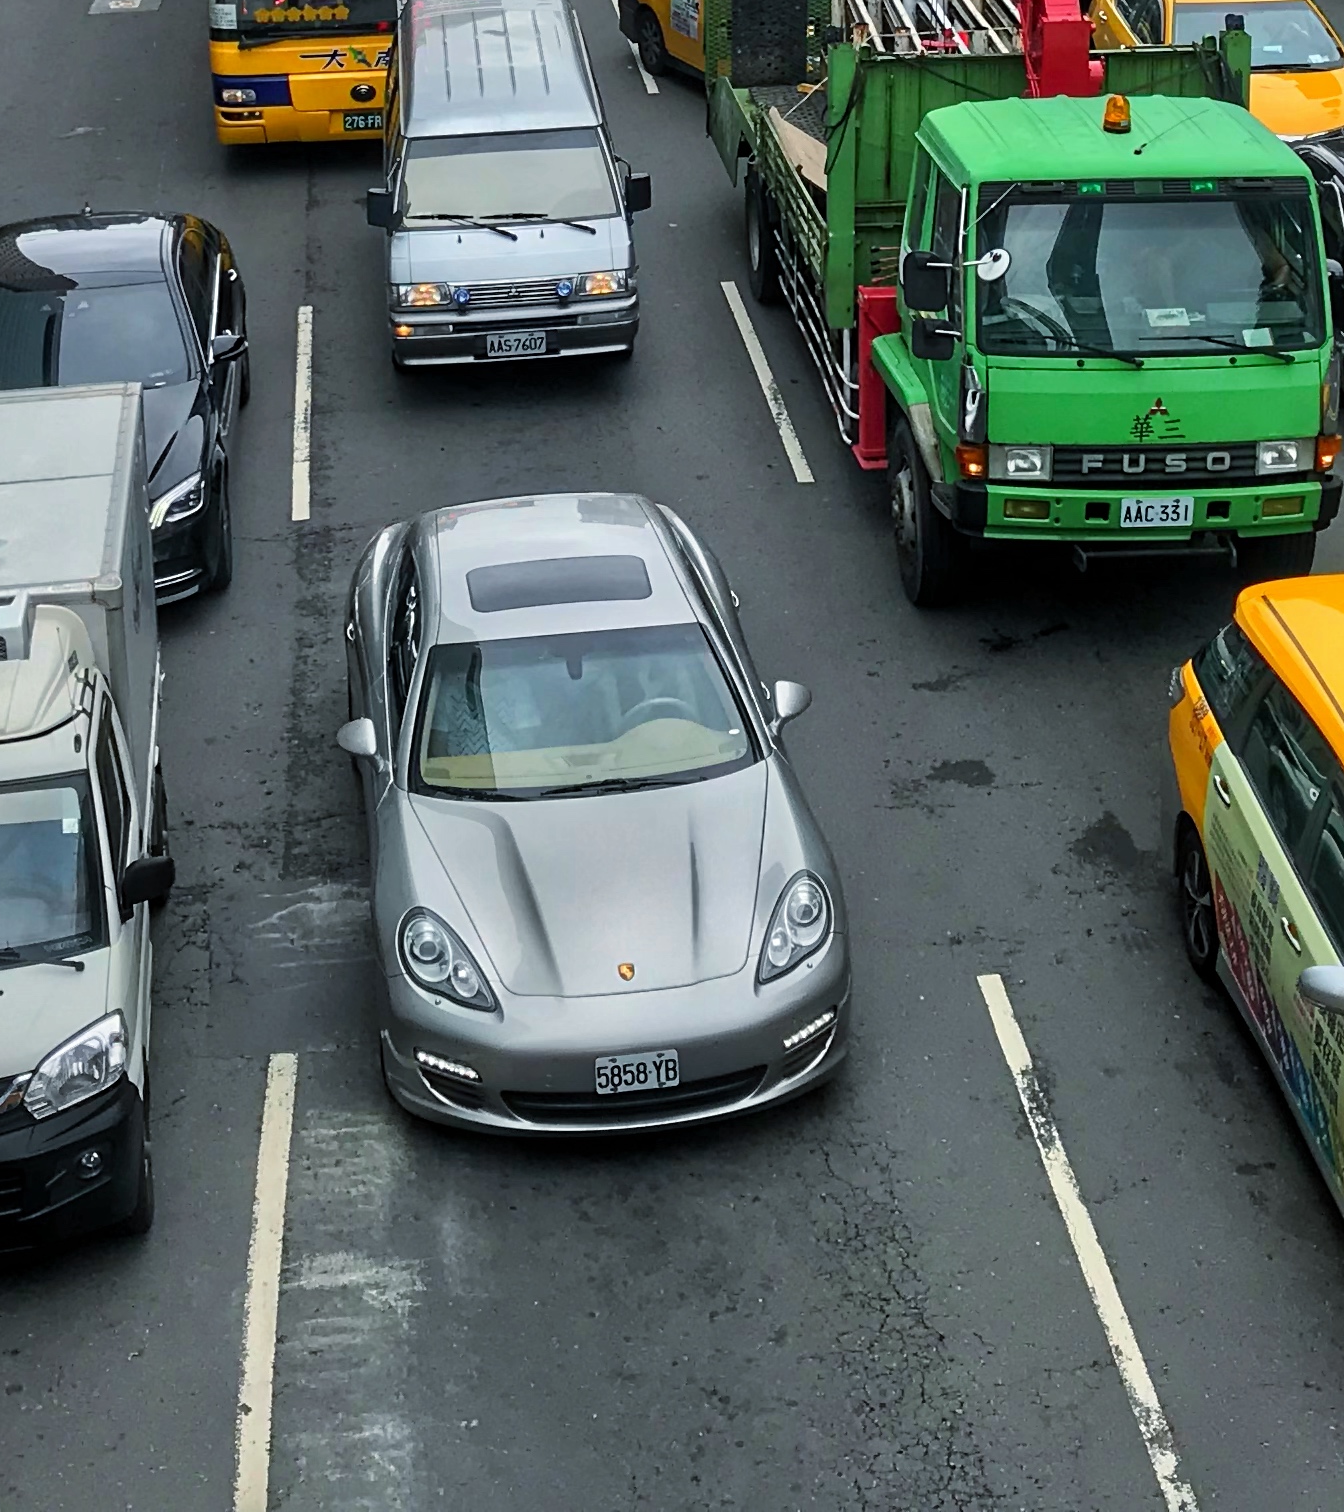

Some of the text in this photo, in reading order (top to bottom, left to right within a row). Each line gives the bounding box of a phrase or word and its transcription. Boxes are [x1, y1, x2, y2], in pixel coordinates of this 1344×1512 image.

[344, 115, 383, 129] 276-FR
[488, 336, 545, 354] AAS-7607
[1081, 450, 1231, 475] FUSO
[1122, 500, 1190, 524] AAC-331
[596, 1059, 678, 1090] 5858-YB
